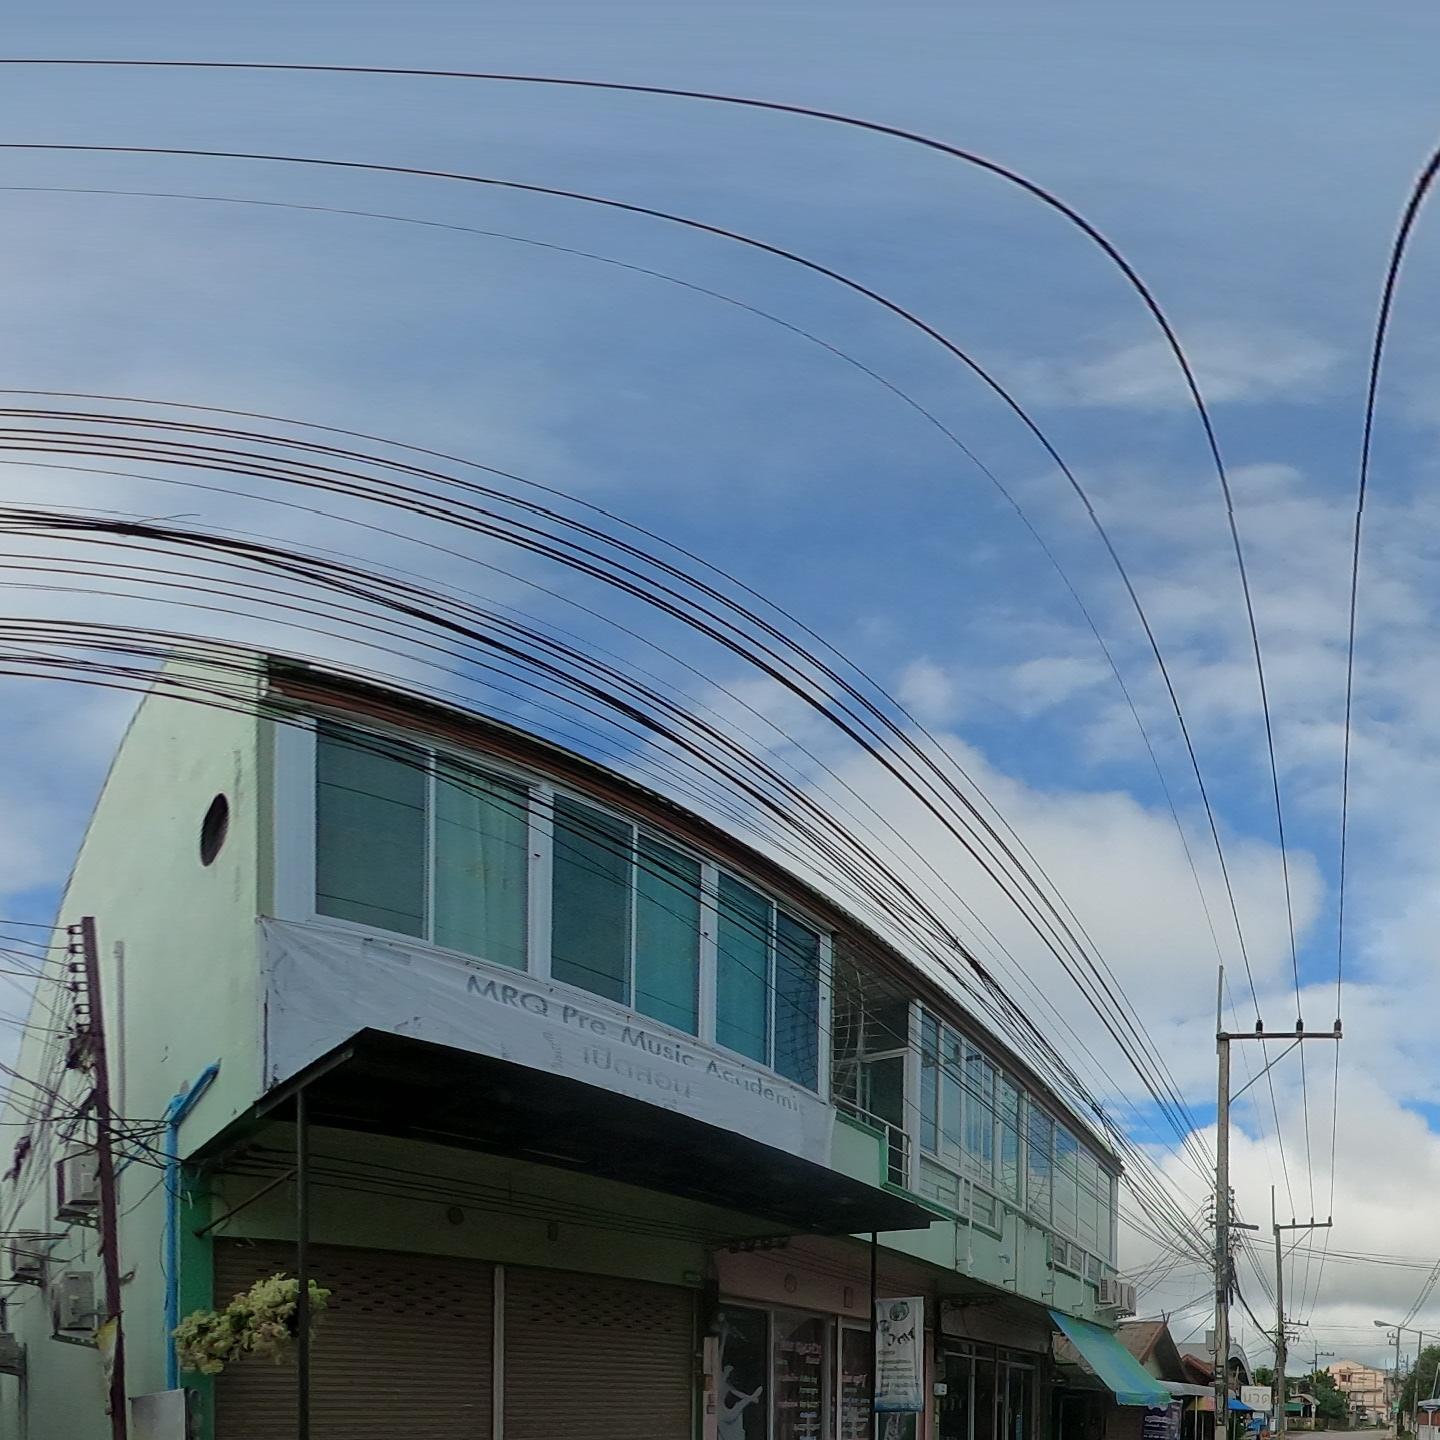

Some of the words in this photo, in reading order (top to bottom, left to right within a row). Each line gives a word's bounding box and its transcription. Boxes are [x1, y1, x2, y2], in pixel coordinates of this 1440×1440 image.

[467, 974, 548, 1018] MRQ
[562, 1004, 608, 1035] Pre
[621, 1027, 696, 1067] Music
